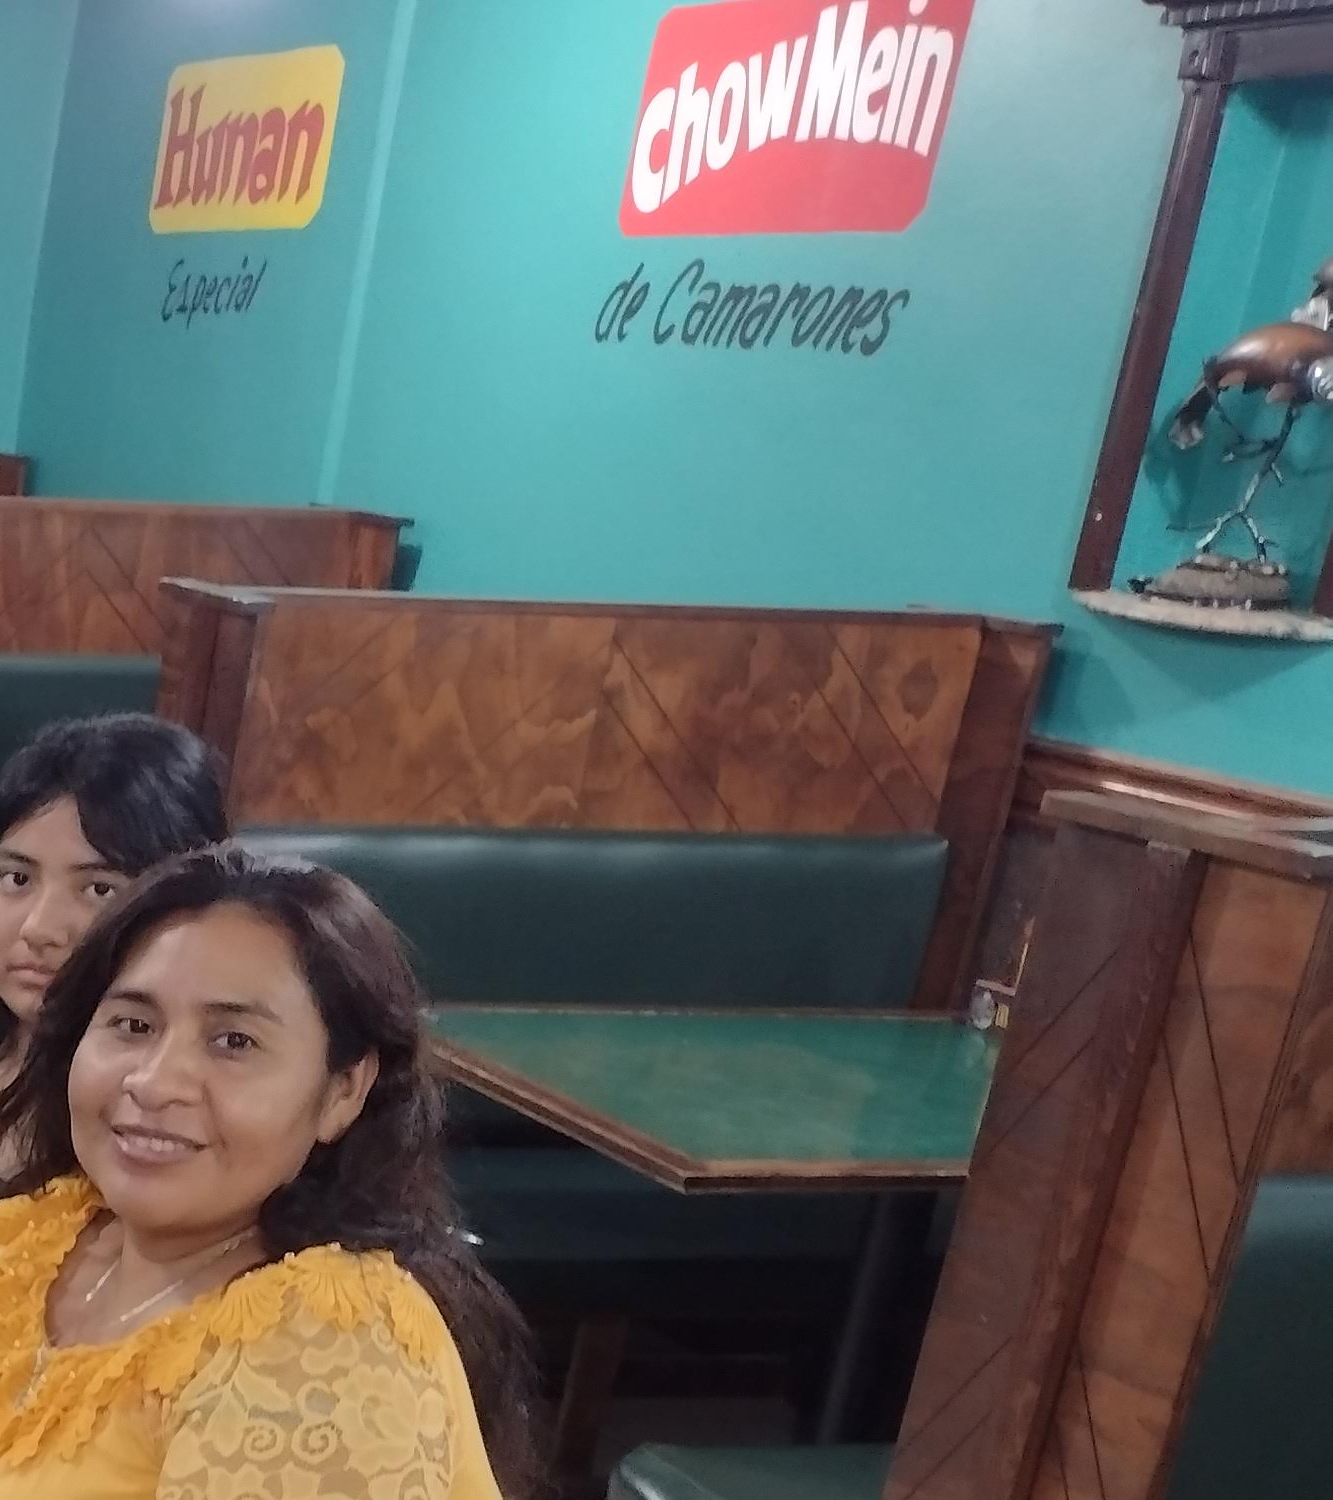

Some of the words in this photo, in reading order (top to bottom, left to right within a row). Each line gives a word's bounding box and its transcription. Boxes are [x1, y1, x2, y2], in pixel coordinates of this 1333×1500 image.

[161, 255, 268, 331] Especial
[595, 261, 651, 344] de
[653, 258, 910, 357] Camarones
